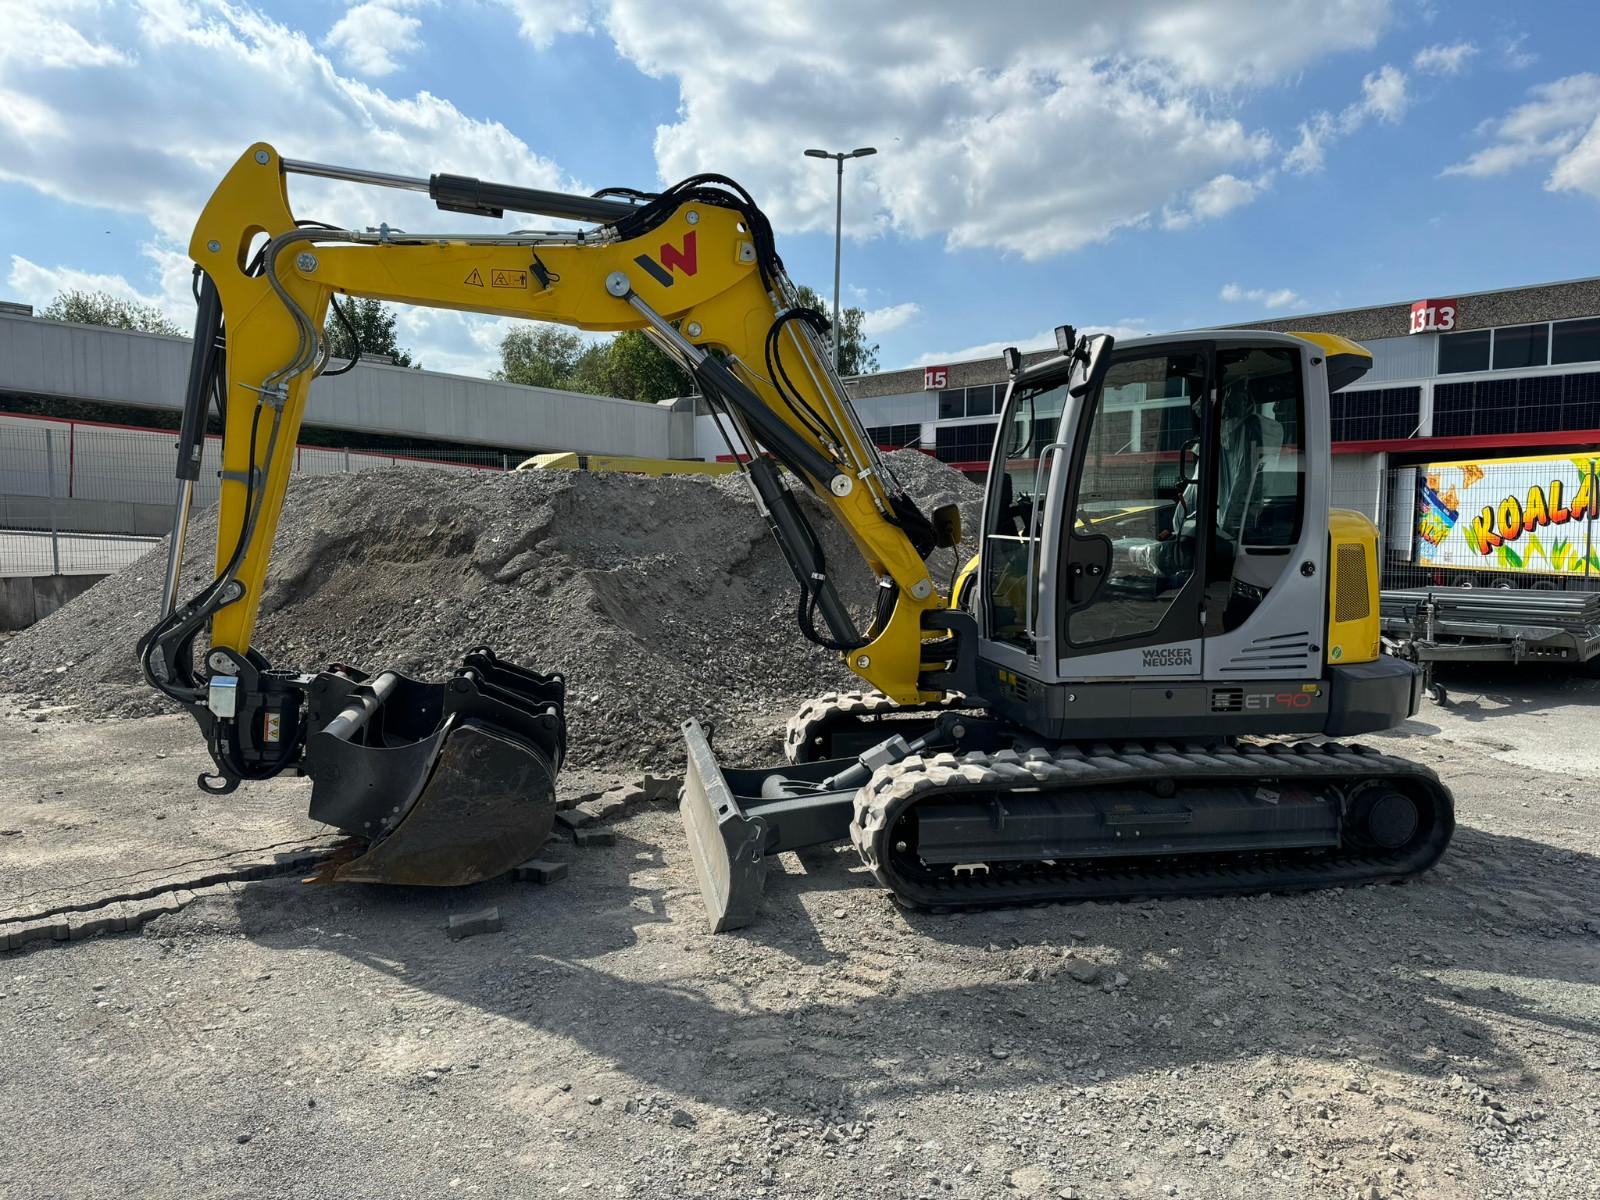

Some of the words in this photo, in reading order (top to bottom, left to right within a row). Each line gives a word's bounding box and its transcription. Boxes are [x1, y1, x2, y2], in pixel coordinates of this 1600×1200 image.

[1408, 308, 1426, 335] 13
[1426, 306, 1455, 331] 13
[926, 371, 947, 389] 15
[1472, 473, 1599, 555] KOALA
[1142, 648, 1192, 658] WACKER
[1142, 657, 1193, 668] NEUSON
[1245, 693, 1313, 709] ET90
